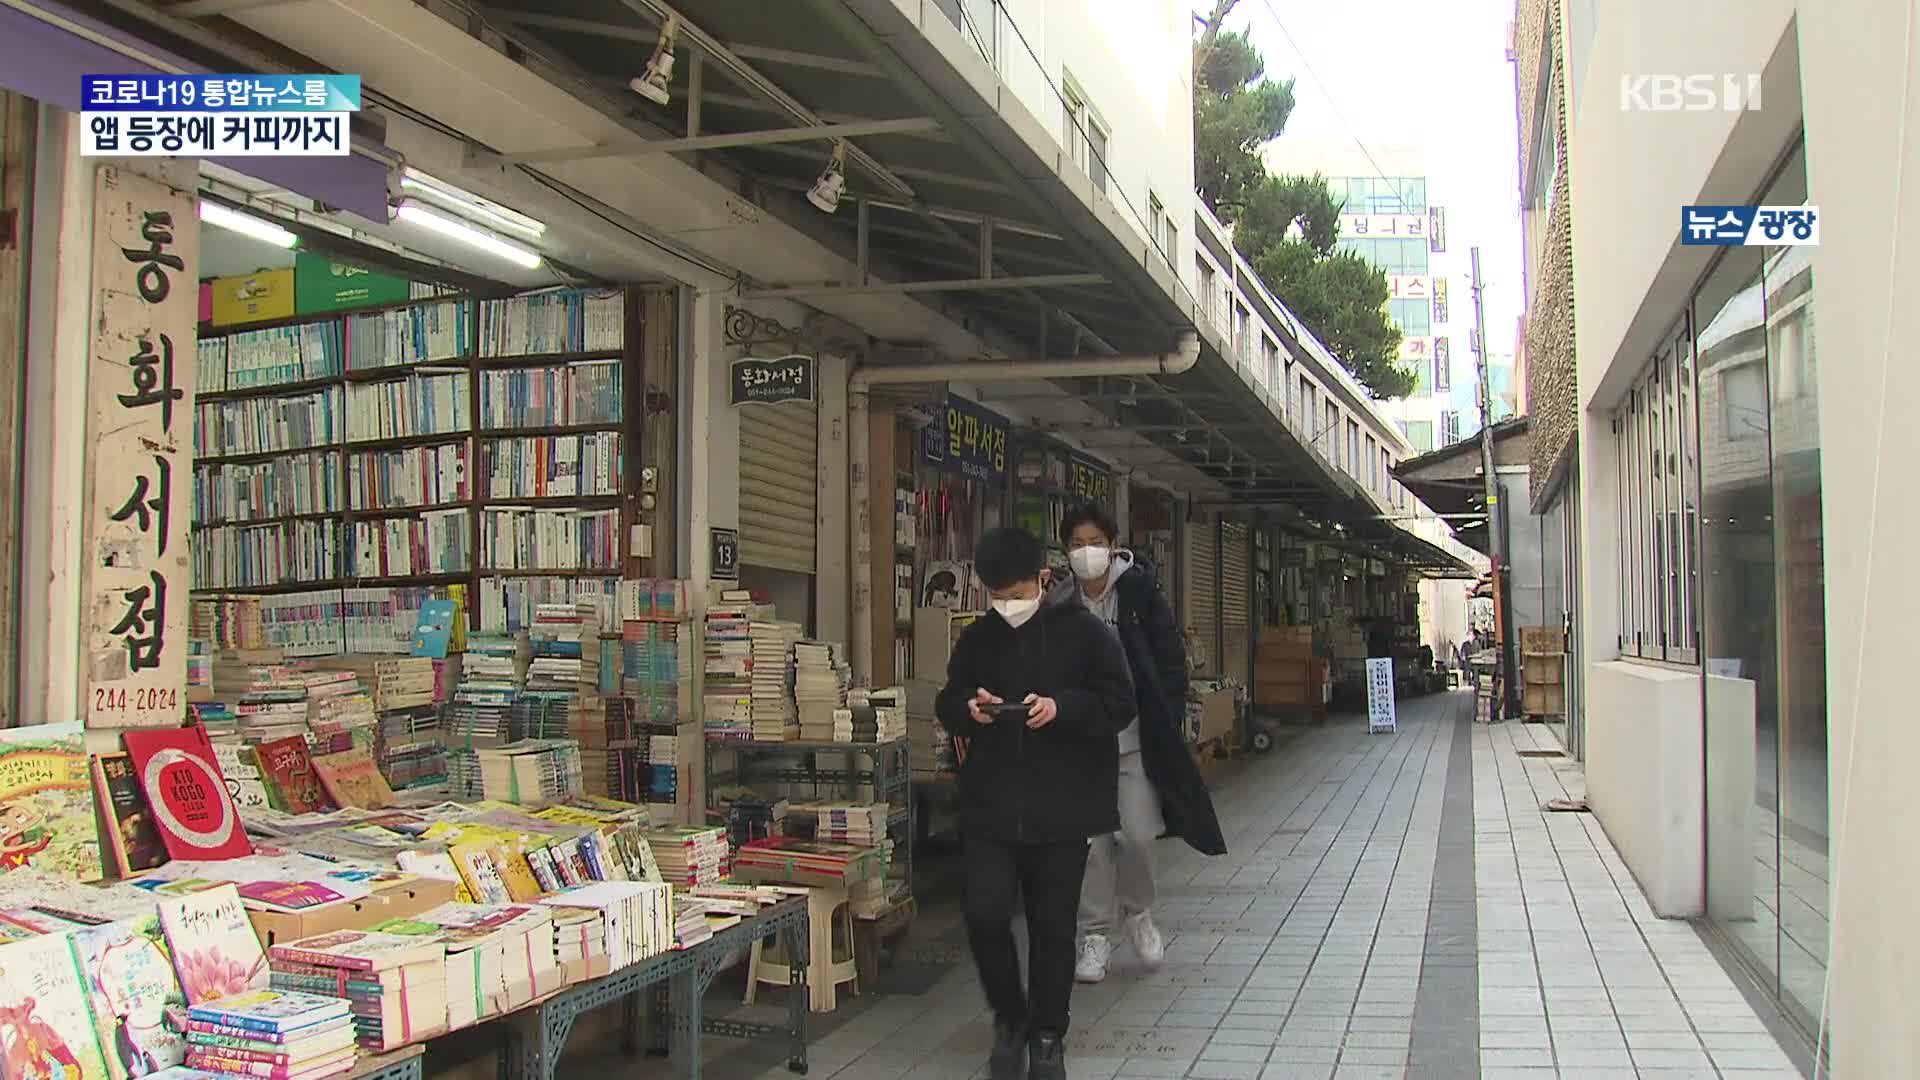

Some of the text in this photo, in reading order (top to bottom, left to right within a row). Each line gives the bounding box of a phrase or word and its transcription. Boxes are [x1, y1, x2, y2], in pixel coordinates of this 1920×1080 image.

[741, 365, 804, 388] 동화서점
[110, 211, 185, 673] 동화서점
[947, 407, 1005, 473] 알파서점
[718, 544, 732, 566] 13
[95, 687, 177, 712] 244-2024
[171, 783, 206, 803] KOGO
